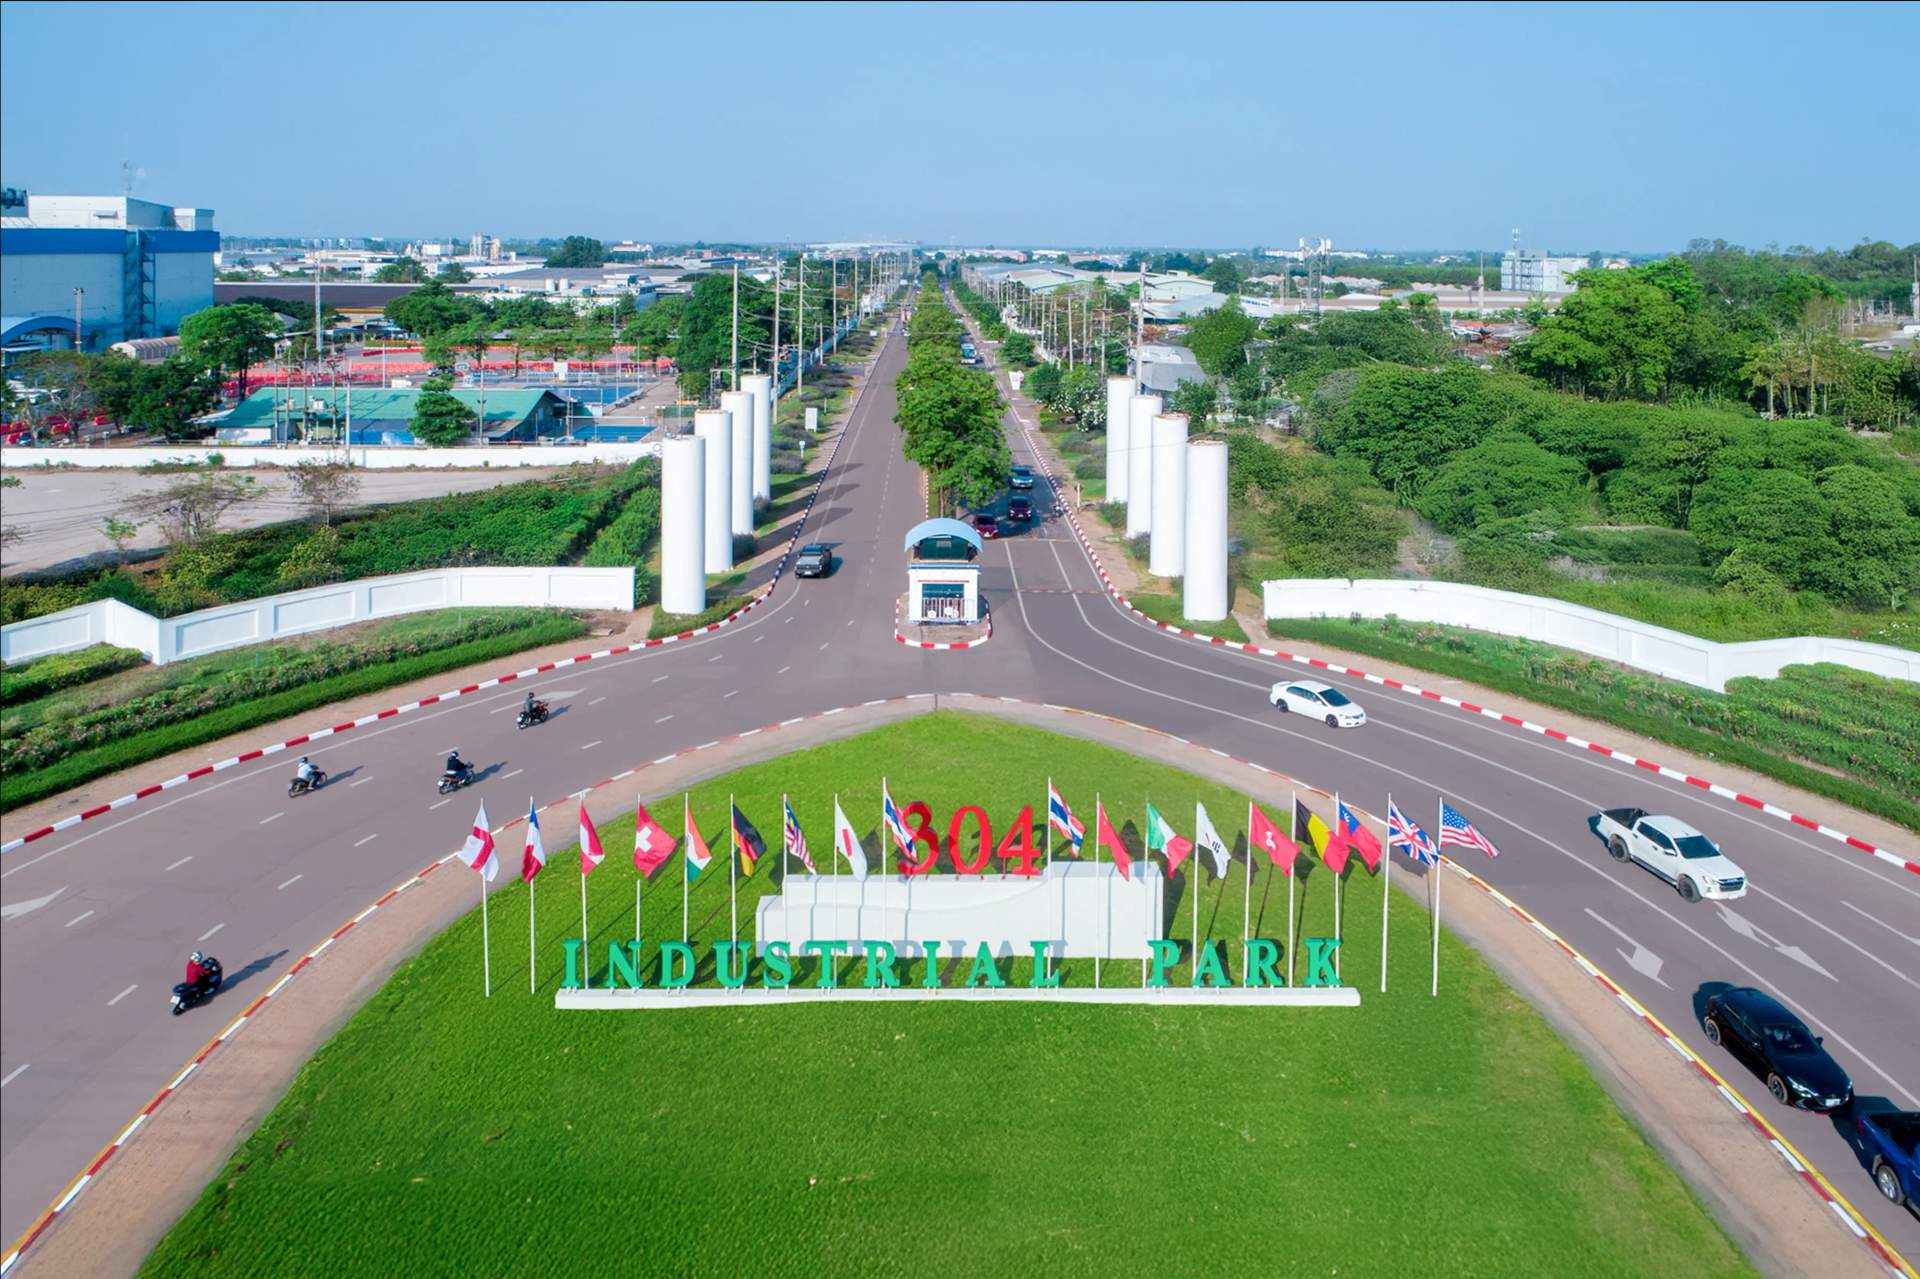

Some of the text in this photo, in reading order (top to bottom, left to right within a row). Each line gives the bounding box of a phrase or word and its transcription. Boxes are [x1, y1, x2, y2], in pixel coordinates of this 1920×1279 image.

[897, 801, 1041, 878] 304
[560, 937, 1343, 988] INDUSTRIAL PARK
